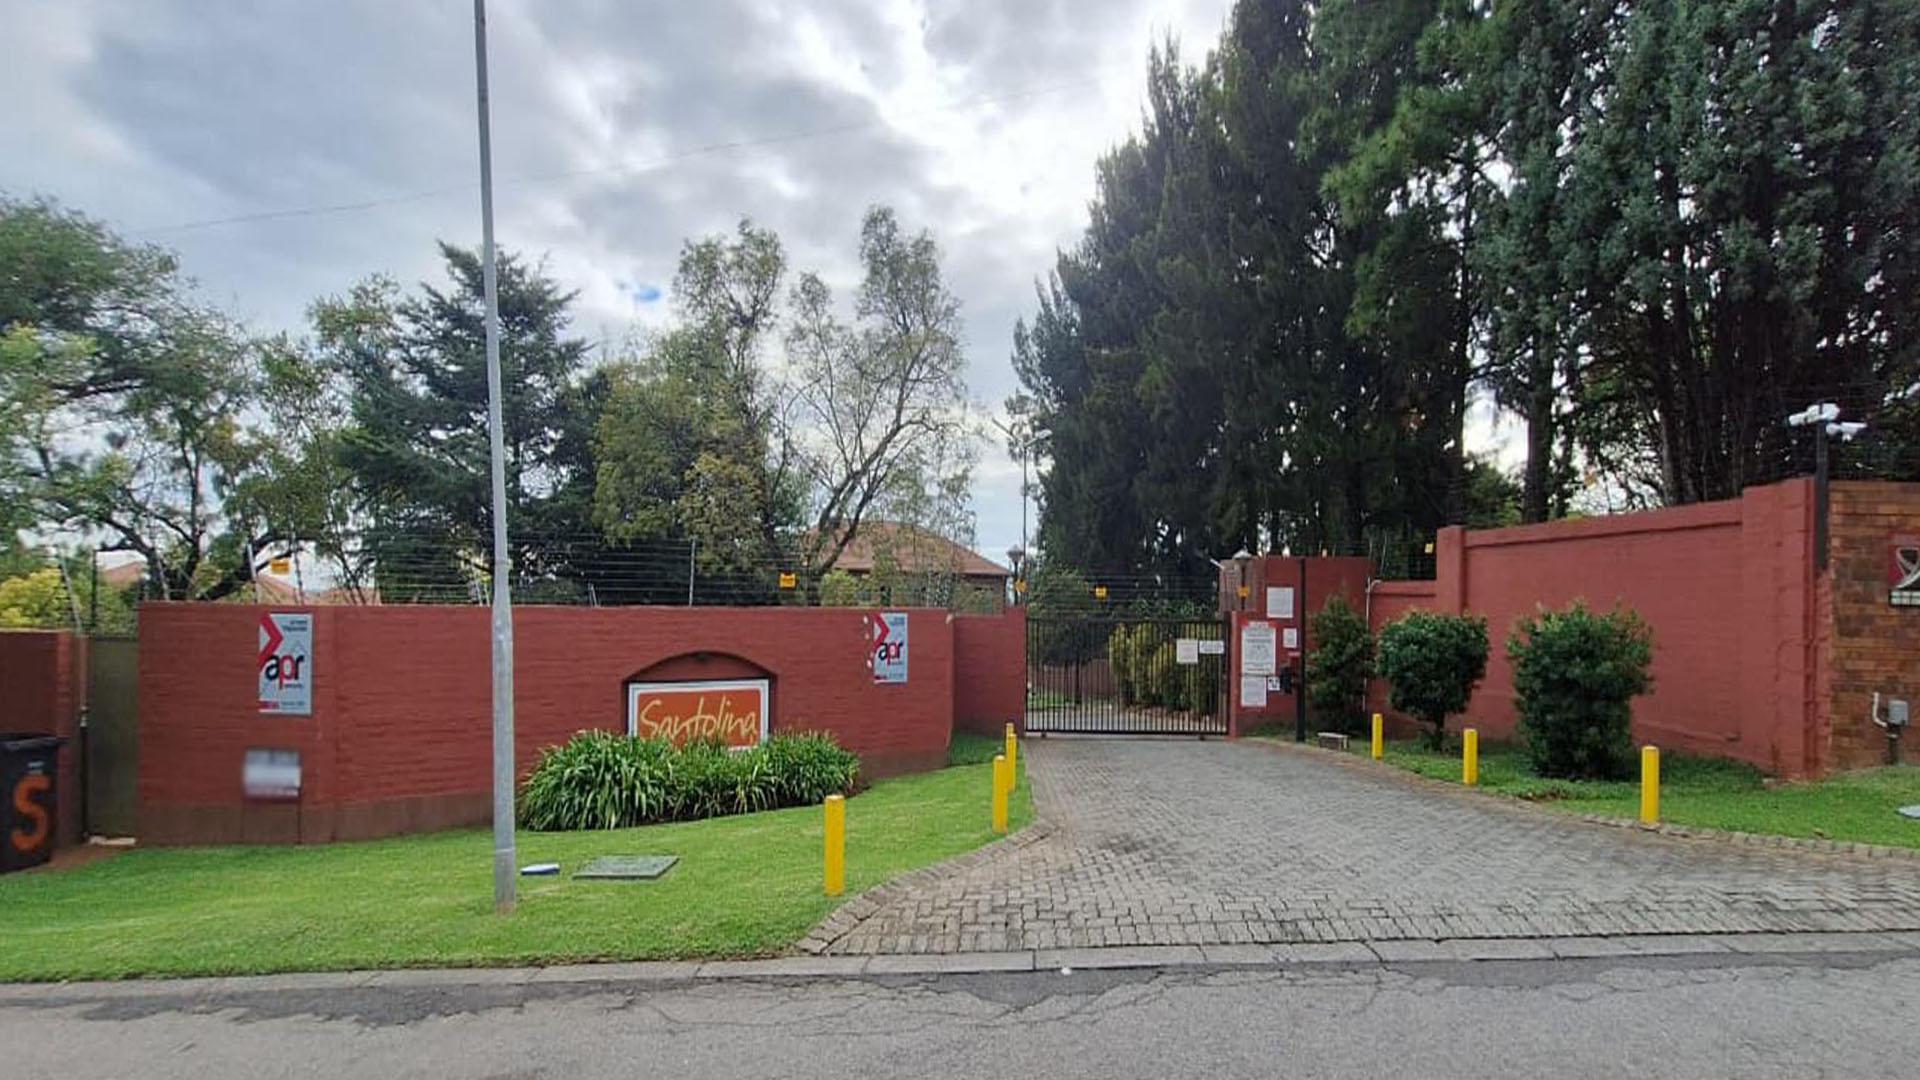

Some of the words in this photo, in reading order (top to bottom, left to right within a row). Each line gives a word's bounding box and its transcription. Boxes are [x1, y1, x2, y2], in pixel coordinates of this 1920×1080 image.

[265, 654, 305, 690] apr
[879, 641, 903, 667] apr
[640, 694, 758, 744] Santolina
